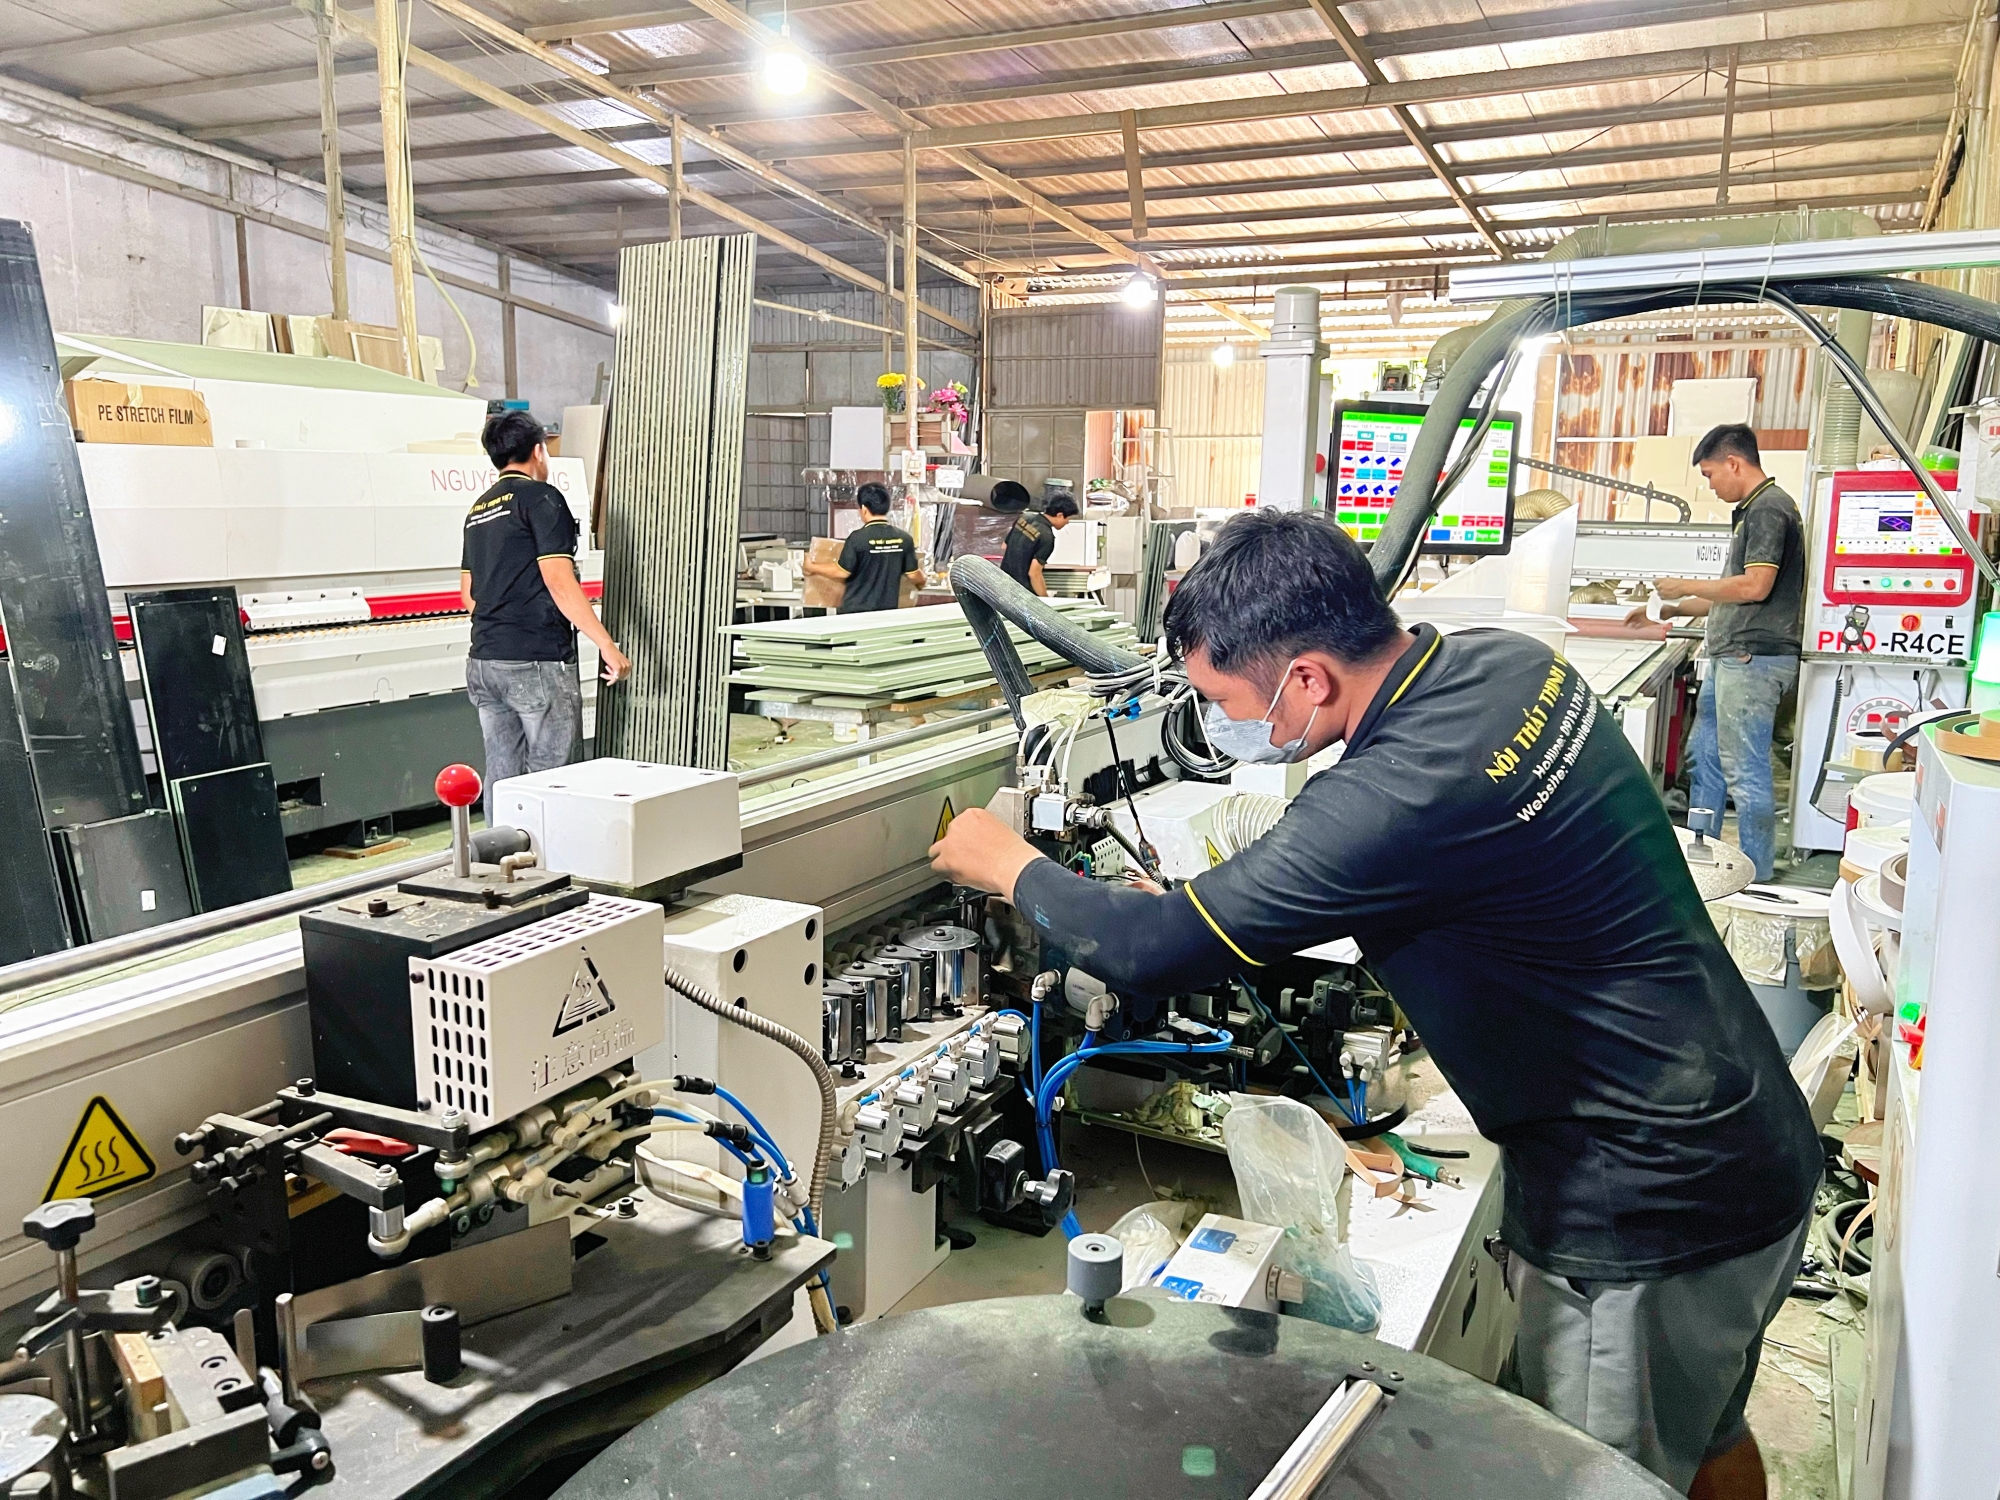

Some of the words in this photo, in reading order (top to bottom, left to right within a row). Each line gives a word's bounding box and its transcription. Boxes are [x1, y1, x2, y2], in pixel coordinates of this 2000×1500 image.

[98, 404, 113, 421] PE
[116, 405, 165, 424] STRETCH
[169, 408, 194, 425] FILM
[430, 468, 497, 492] NGUYÊ
[1484, 747, 1521, 784] NỘI
[1513, 704, 1549, 750] THẤT
[1538, 665, 1567, 708] THỊNH
[1532, 733, 1567, 780] Hotline:
[1516, 765, 1570, 823] Website:
[530, 1018, 636, 1094] 注意高温
